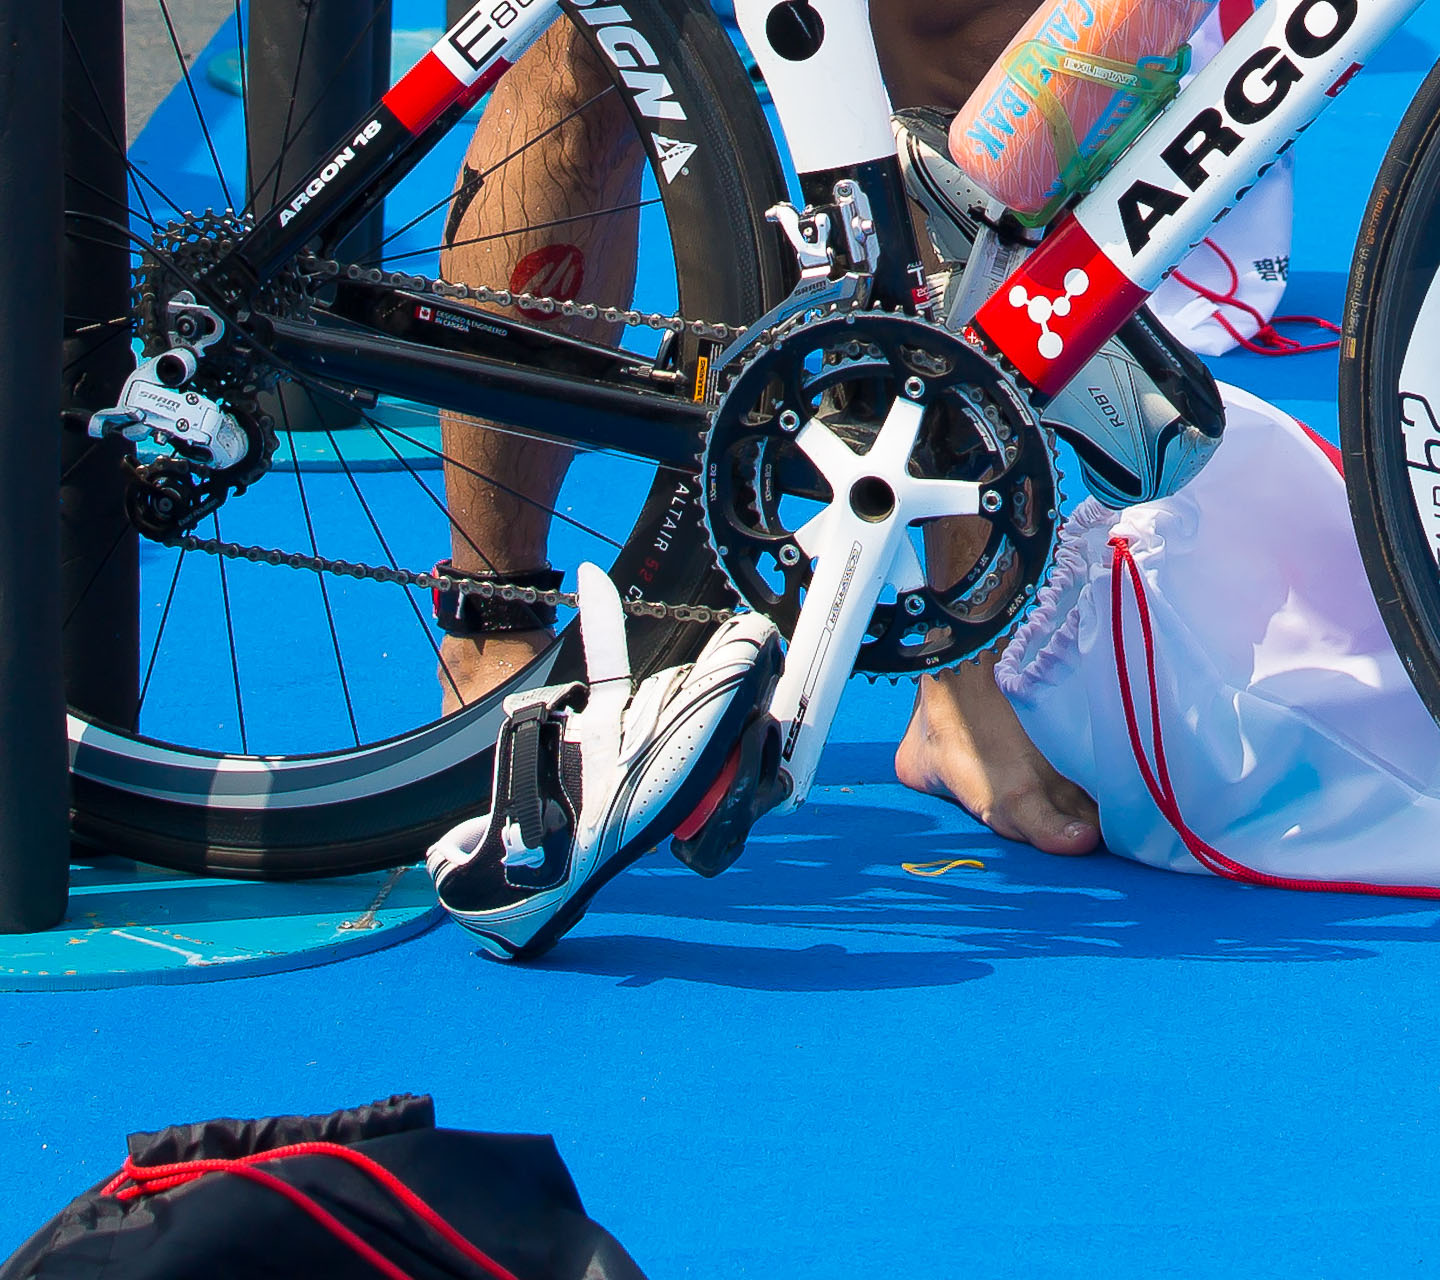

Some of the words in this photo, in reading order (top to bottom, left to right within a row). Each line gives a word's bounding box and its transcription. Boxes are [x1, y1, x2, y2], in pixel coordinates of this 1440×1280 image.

[278, 146, 356, 228] ARGON
[352, 119, 383, 154] 18
[138, 390, 181, 410] SRAM
[654, 482, 691, 552] ALTAIR
